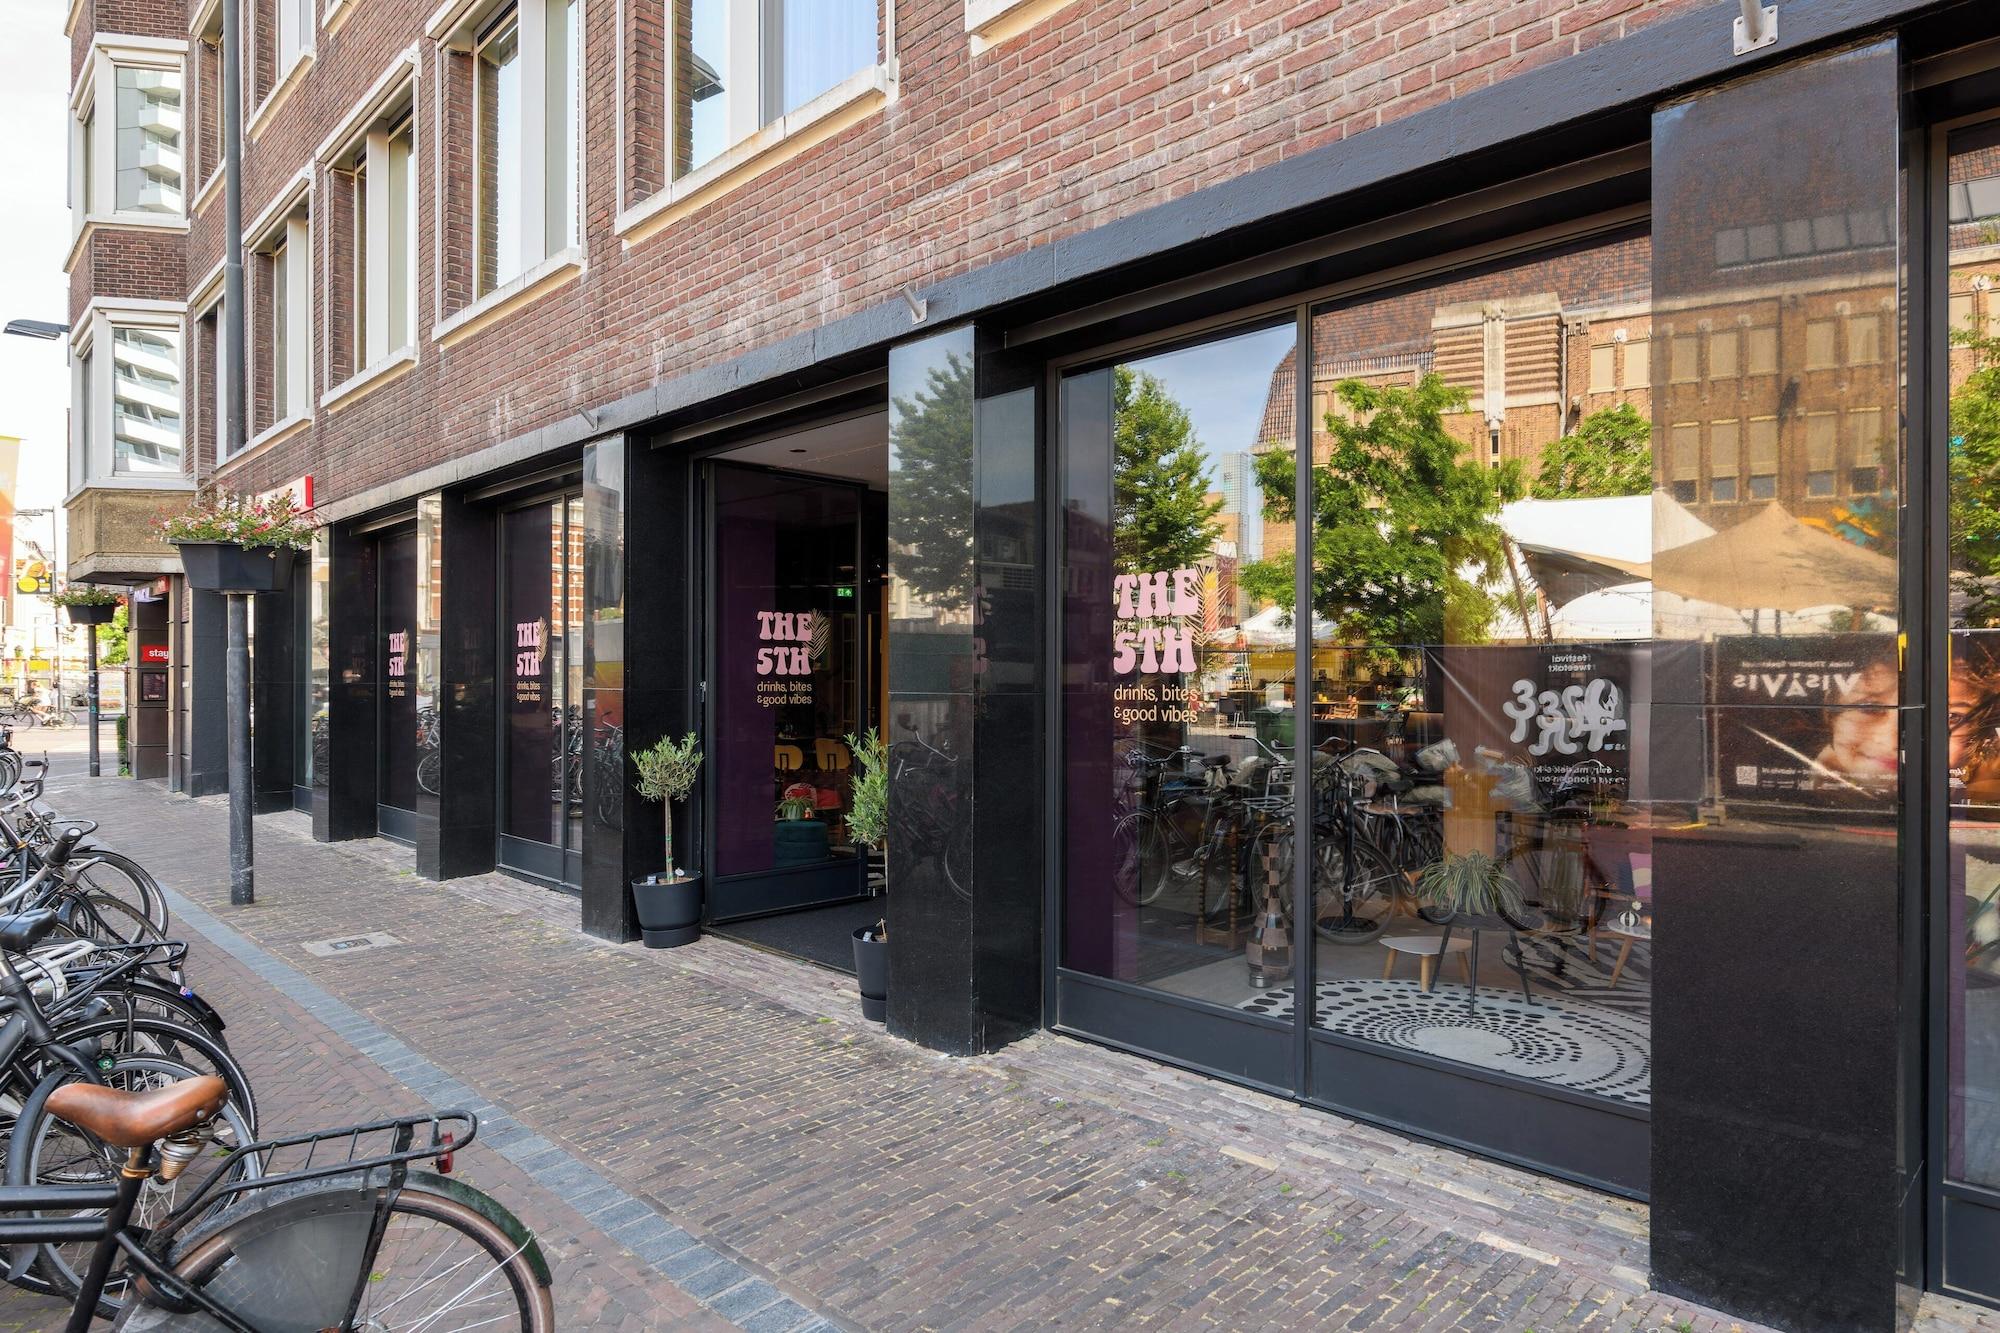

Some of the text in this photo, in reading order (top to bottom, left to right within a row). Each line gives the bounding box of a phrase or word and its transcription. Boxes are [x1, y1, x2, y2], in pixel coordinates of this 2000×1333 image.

[1113, 569, 1199, 619] THE
[517, 622, 541, 648] THE
[757, 611, 813, 641] THE
[389, 632, 405, 653] THE
[1113, 627, 1198, 675] 5TH
[517, 651, 541, 677] 5TH
[757, 646, 812, 676] 5TH
[757, 681, 813, 692] drinks, bites
[789, 694, 813, 705] vibes
[1114, 684, 1199, 702] drinks, bites
[1161, 705, 1198, 723] vibes
